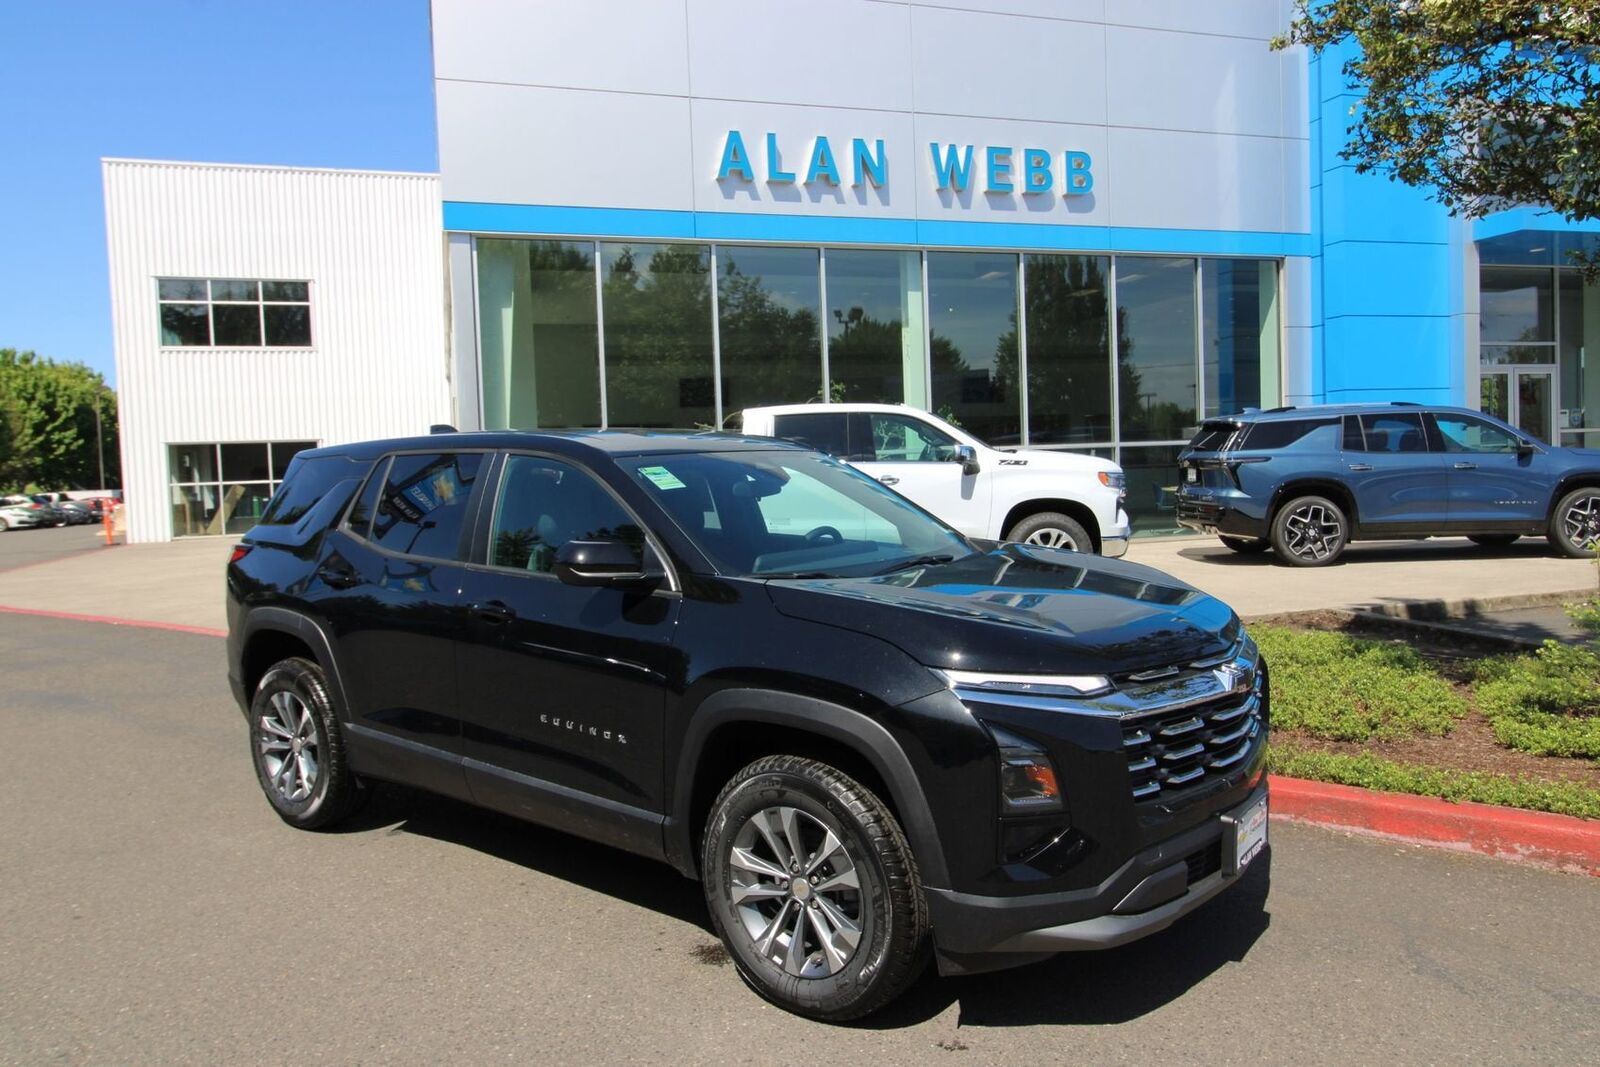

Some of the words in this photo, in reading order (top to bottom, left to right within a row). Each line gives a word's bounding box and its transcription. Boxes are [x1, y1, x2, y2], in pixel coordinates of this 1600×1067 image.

[716, 130, 886, 188] ALAN
[929, 142, 1094, 197] WEBB
[540, 713, 627, 744] EQUINOX
